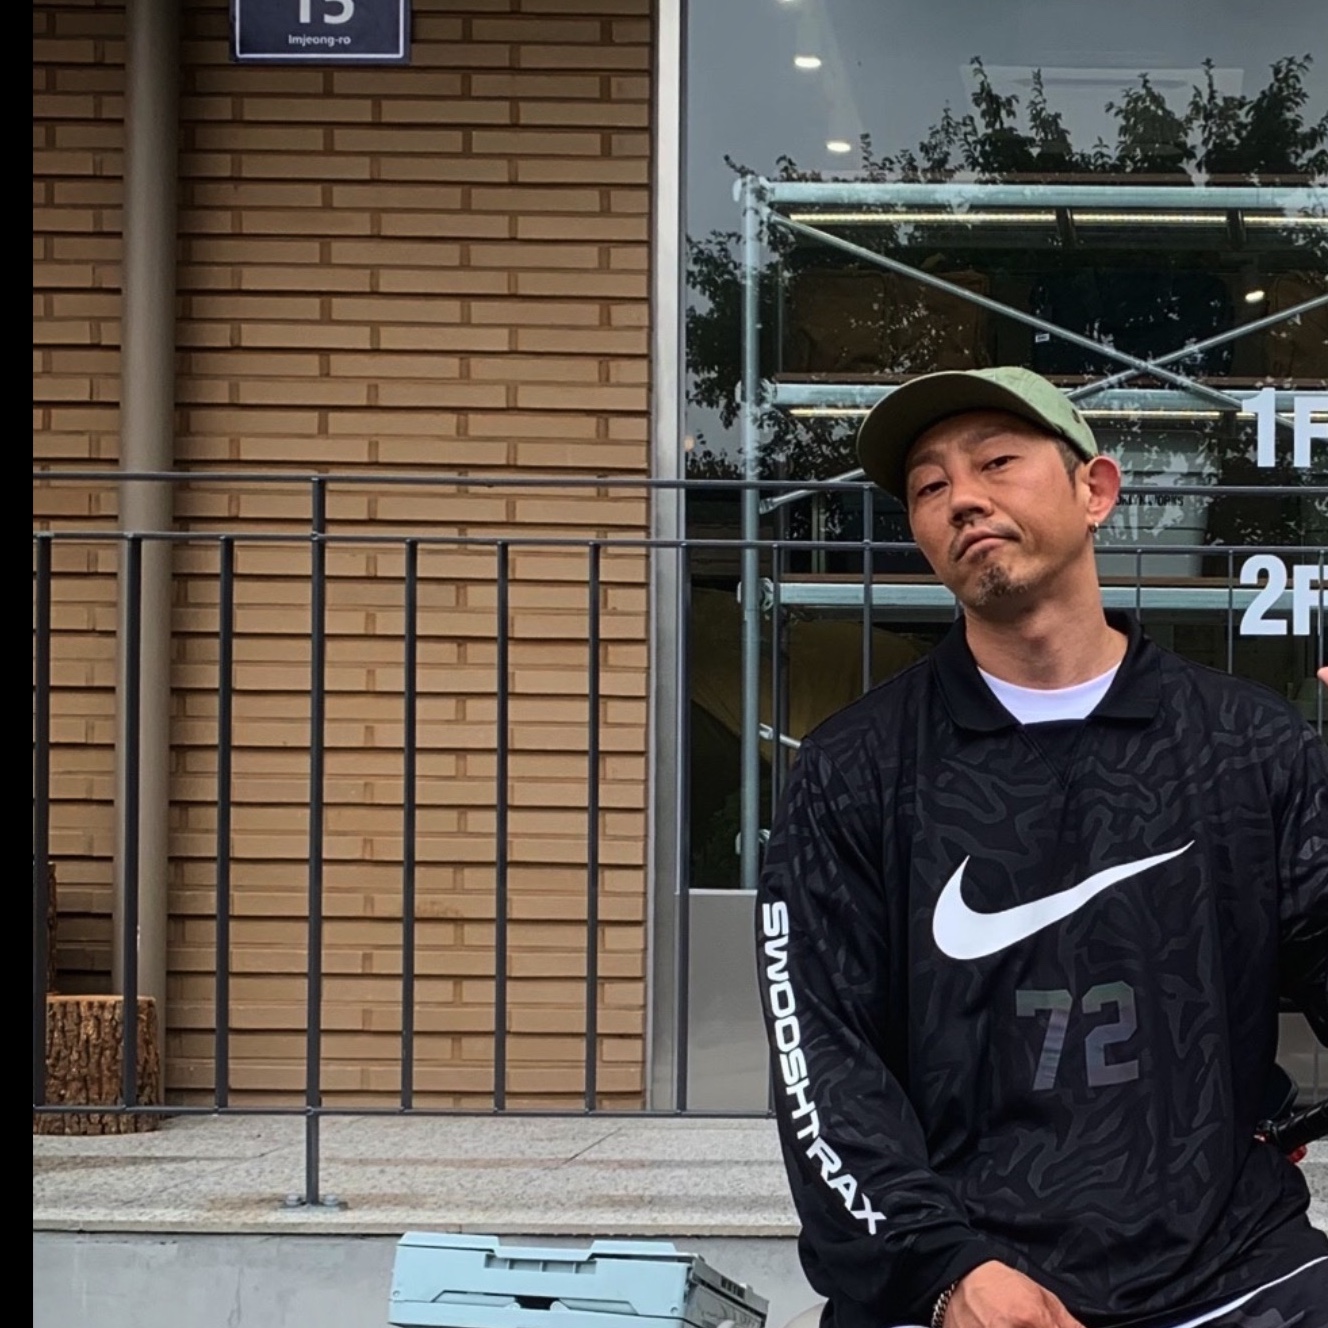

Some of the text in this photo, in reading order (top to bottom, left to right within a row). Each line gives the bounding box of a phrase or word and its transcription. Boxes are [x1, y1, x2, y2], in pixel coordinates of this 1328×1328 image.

[288, 34, 352, 47] Imjeong-ro
[762, 900, 888, 1236] SWOOSHTRAX
[1015, 980, 1140, 1091] 72
